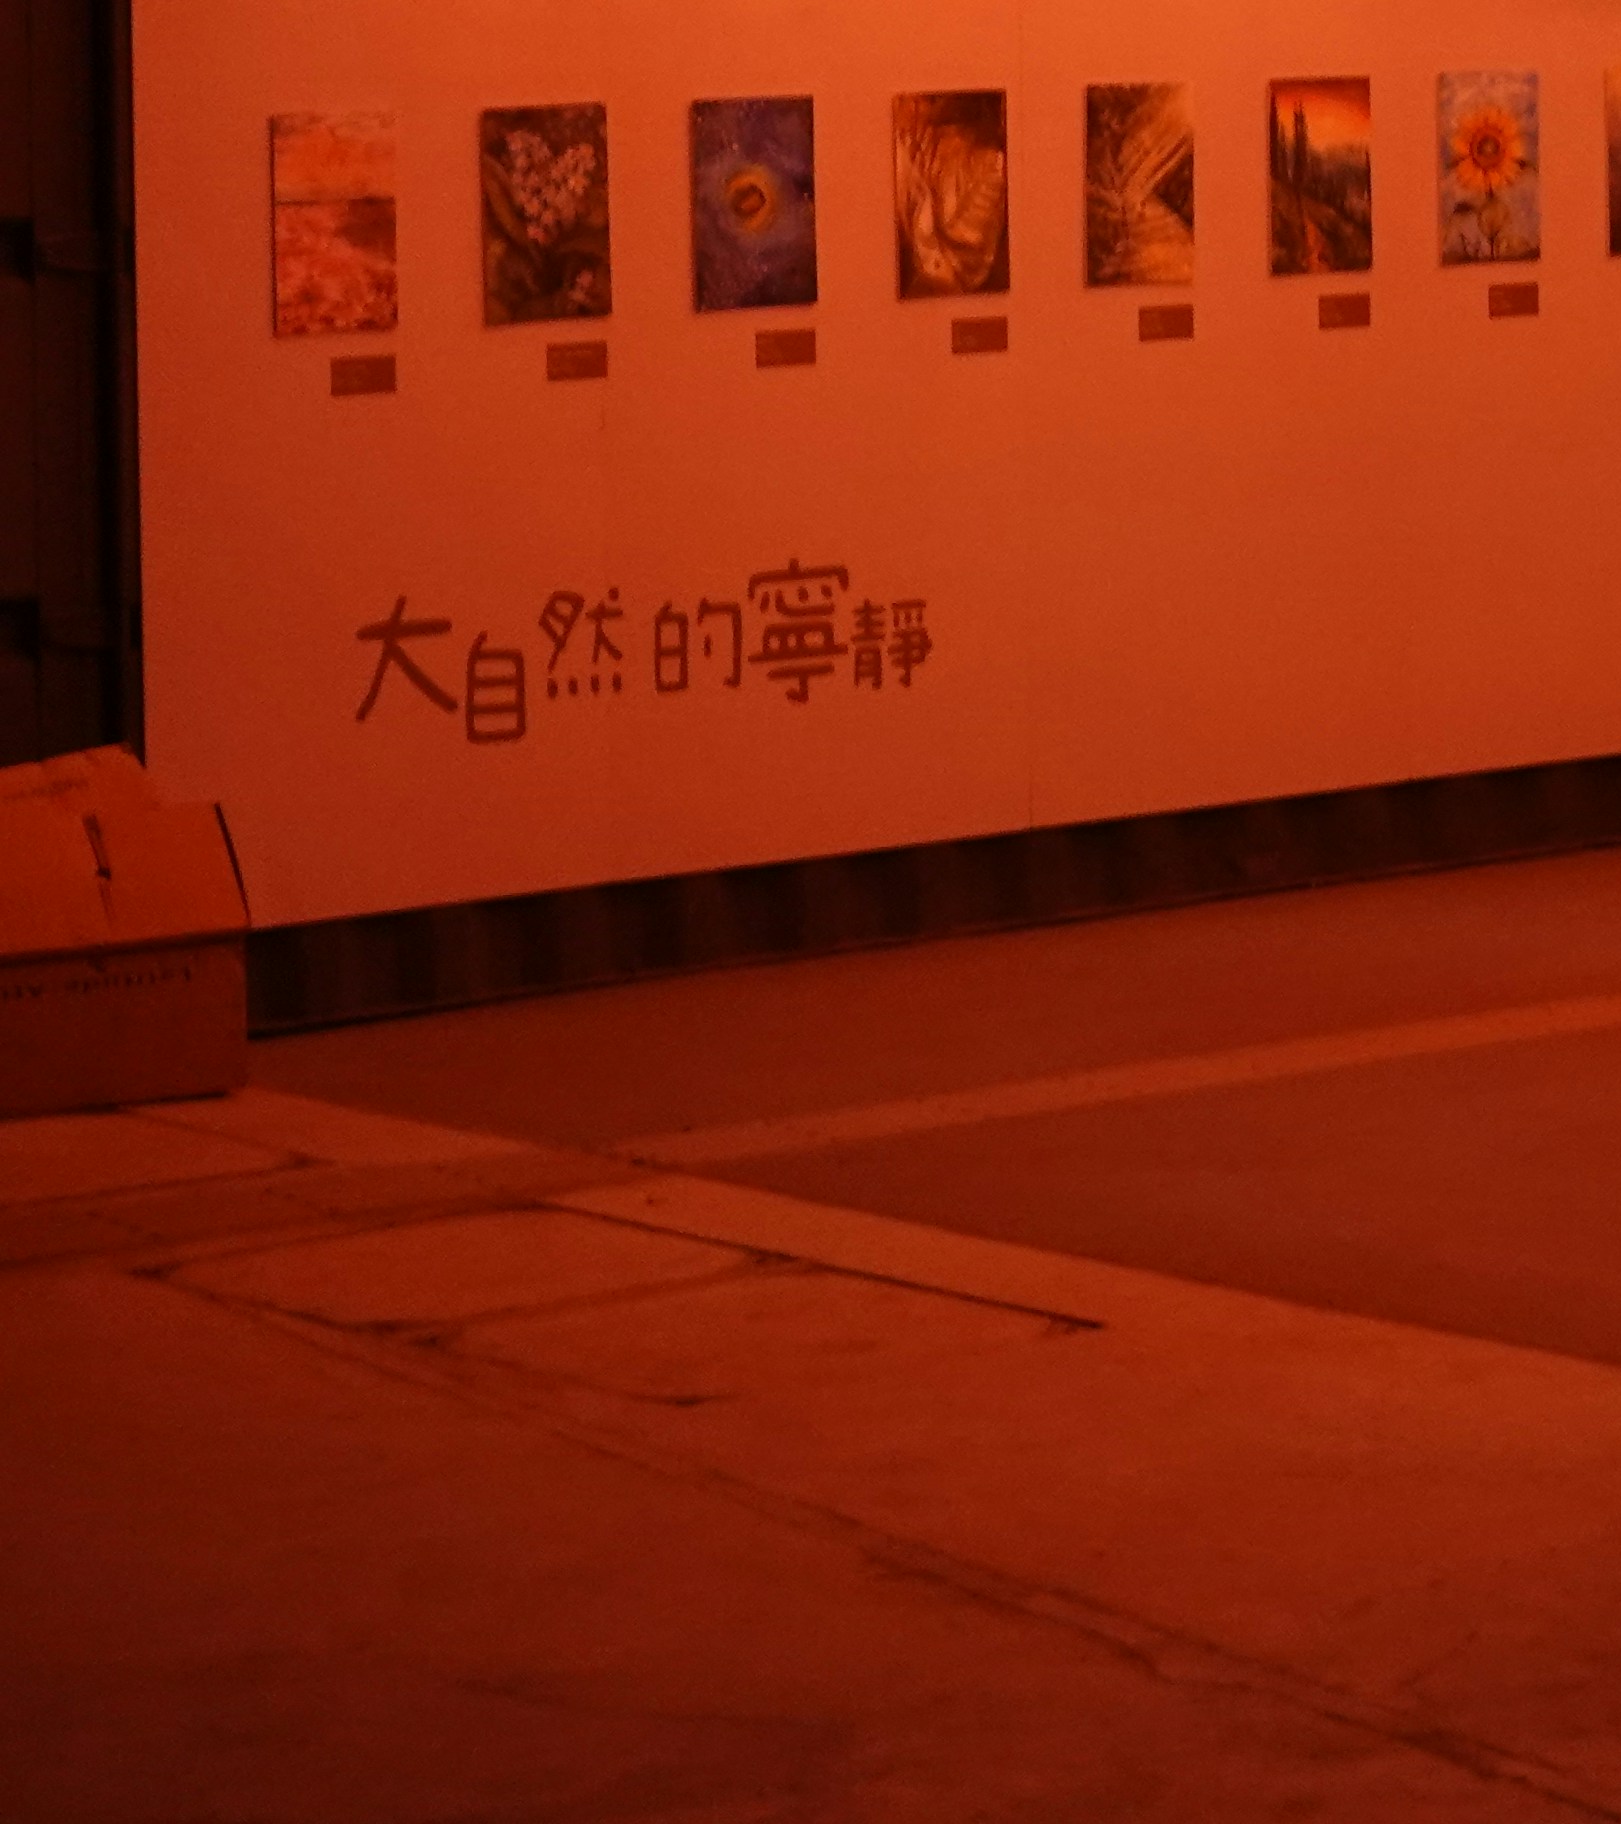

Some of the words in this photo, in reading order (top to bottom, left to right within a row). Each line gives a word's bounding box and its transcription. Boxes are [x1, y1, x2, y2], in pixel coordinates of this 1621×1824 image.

[355, 558, 933, 744] 大自然的寧靜
